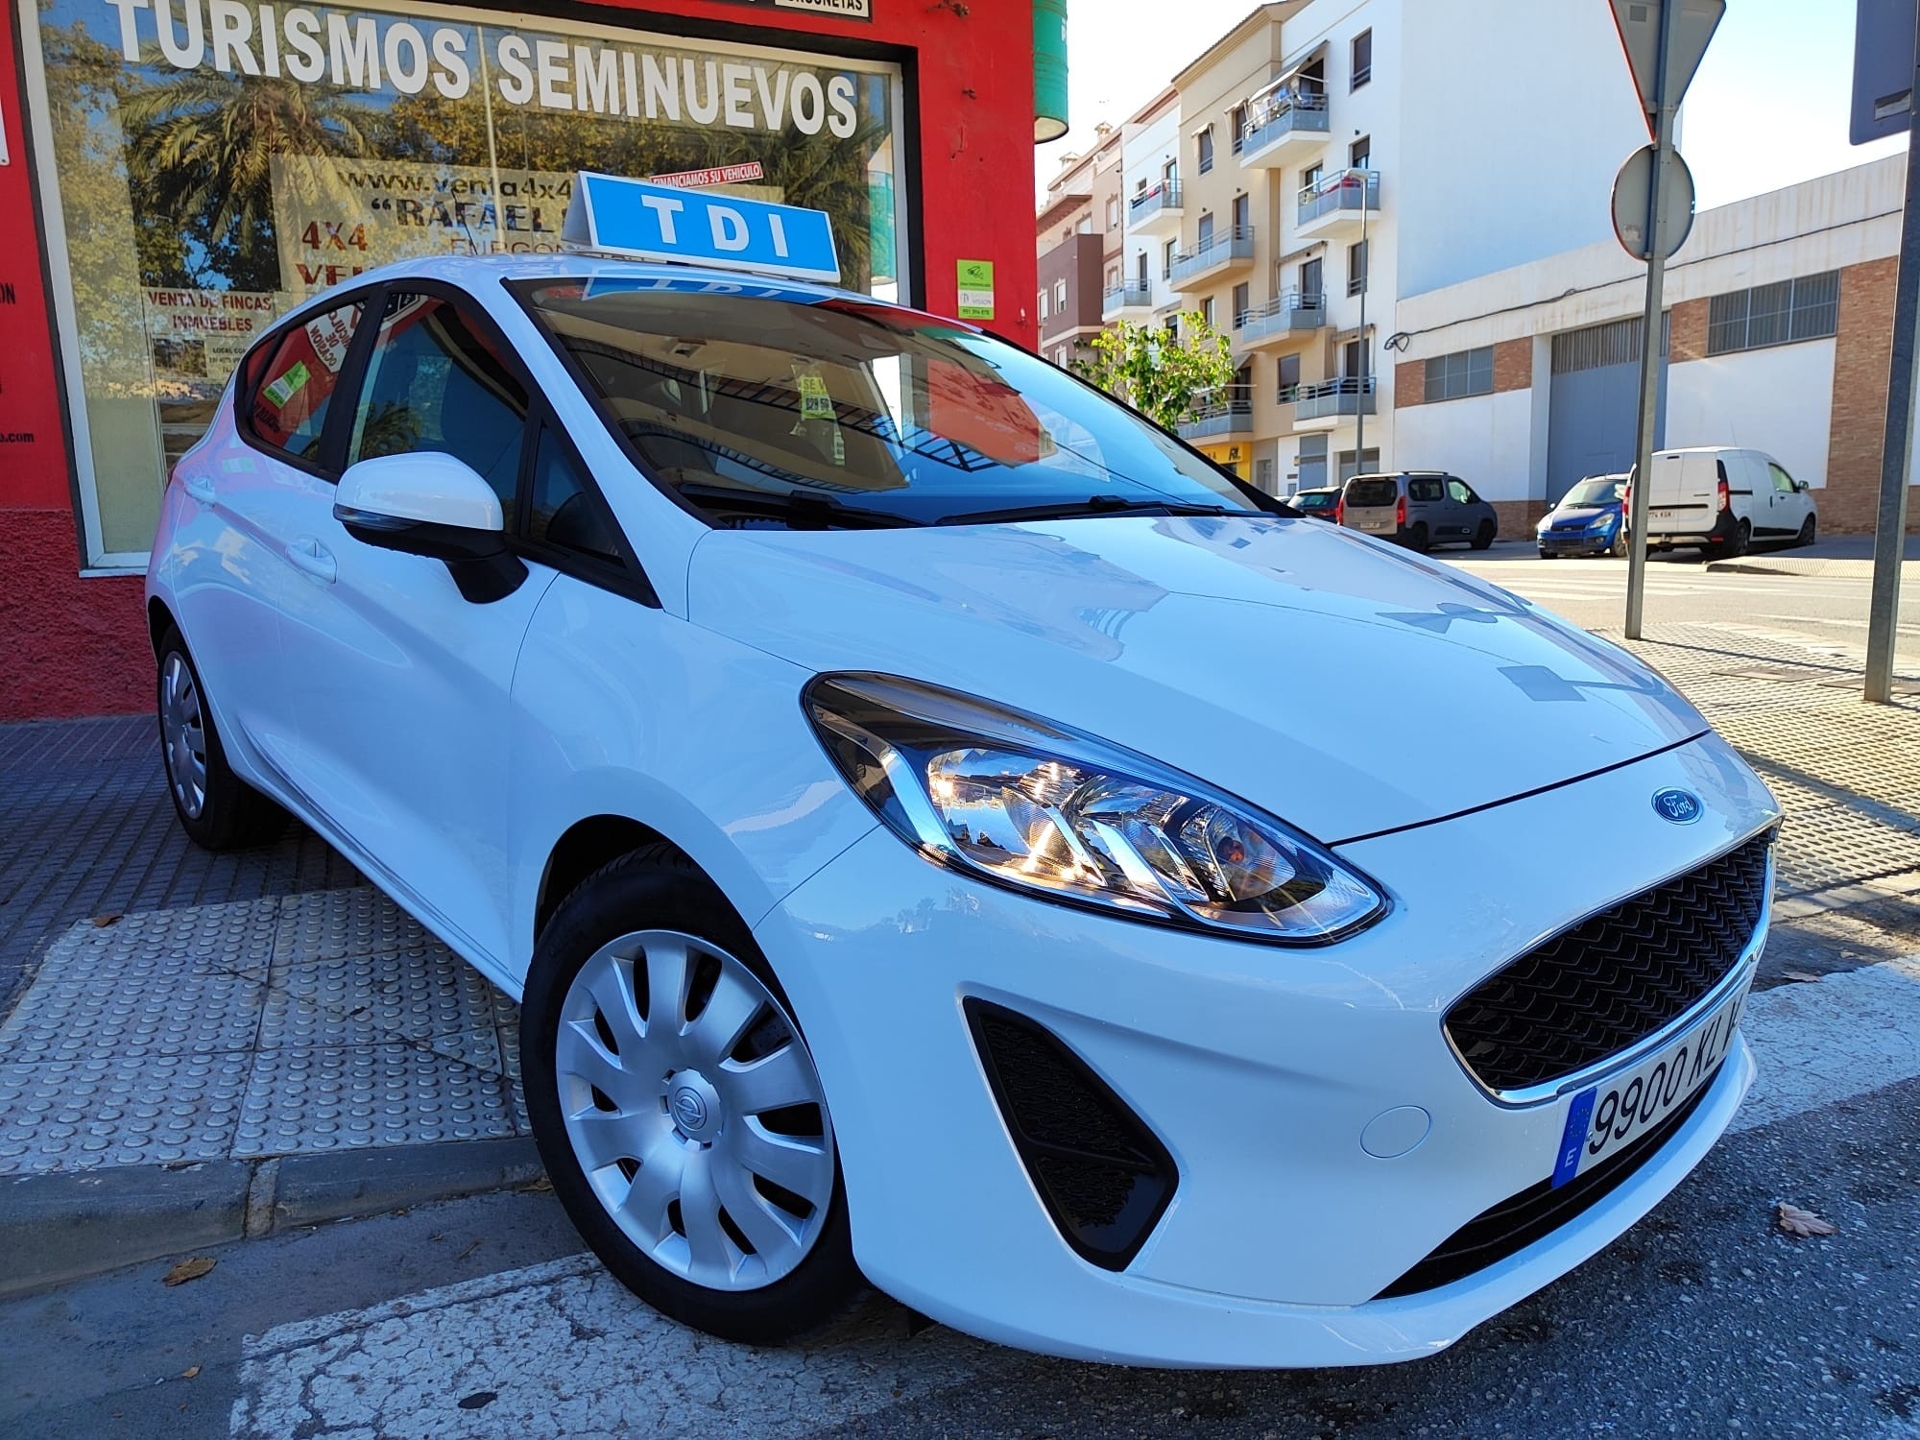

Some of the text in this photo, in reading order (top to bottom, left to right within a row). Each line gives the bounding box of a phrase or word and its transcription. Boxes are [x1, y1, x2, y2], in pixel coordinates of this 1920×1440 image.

[105, 0, 858, 139] TURISMOS SEMINUEVOS
[709, 169, 721, 183] SU
[721, 164, 760, 181] VEHICULO
[302, 221, 368, 251] 4X4
[296, 263, 374, 287] VE
[148, 291, 272, 311] VENTA DE FINCAS
[172, 315, 253, 332] INMUEBLES
[1663, 794, 1694, 817] Ford
[1588, 1046, 1688, 1155] 9900
